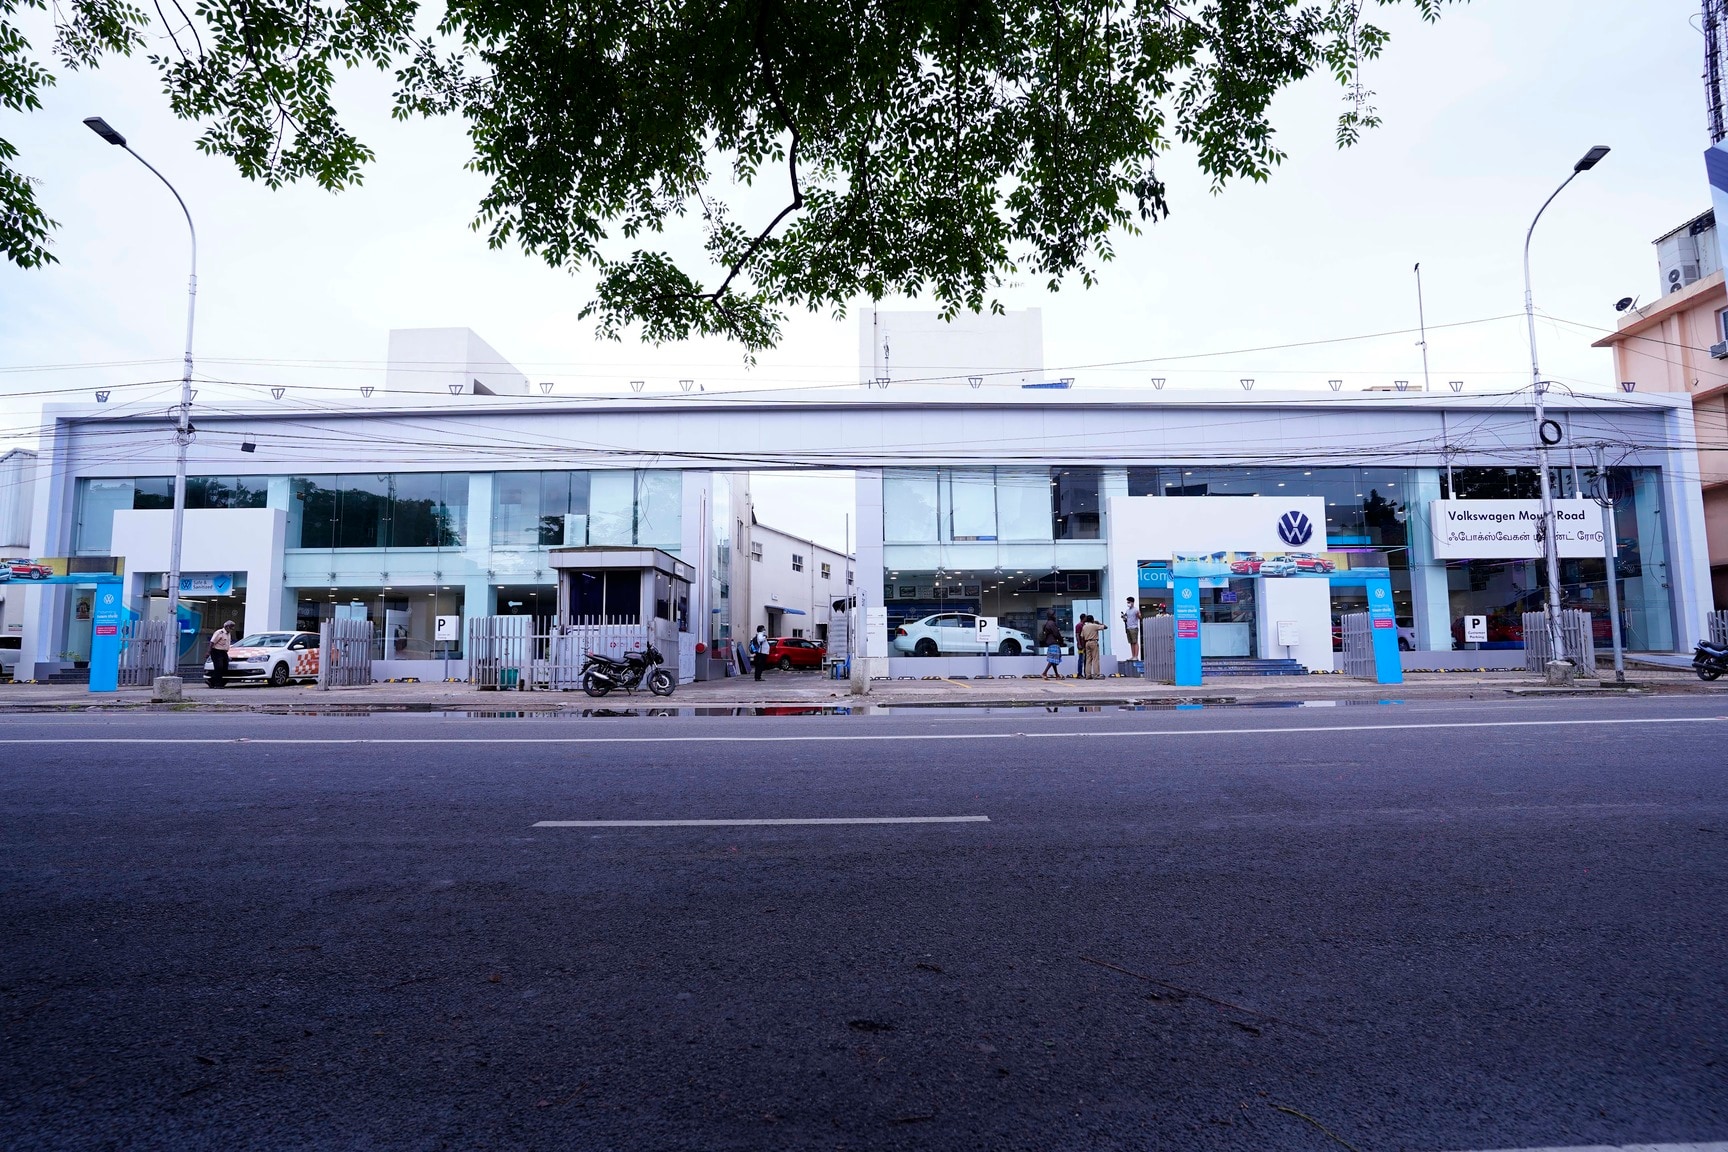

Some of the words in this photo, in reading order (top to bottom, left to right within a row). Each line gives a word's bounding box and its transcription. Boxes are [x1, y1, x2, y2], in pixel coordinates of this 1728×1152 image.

[1448, 510, 1515, 523] Volkswagen
[1519, 510, 1552, 521] Mou
[1557, 510, 1585, 520] Road
[1278, 510, 1313, 546] VW
[438, 618, 446, 631] P
[979, 619, 987, 632] P
[1472, 618, 1480, 629] P
